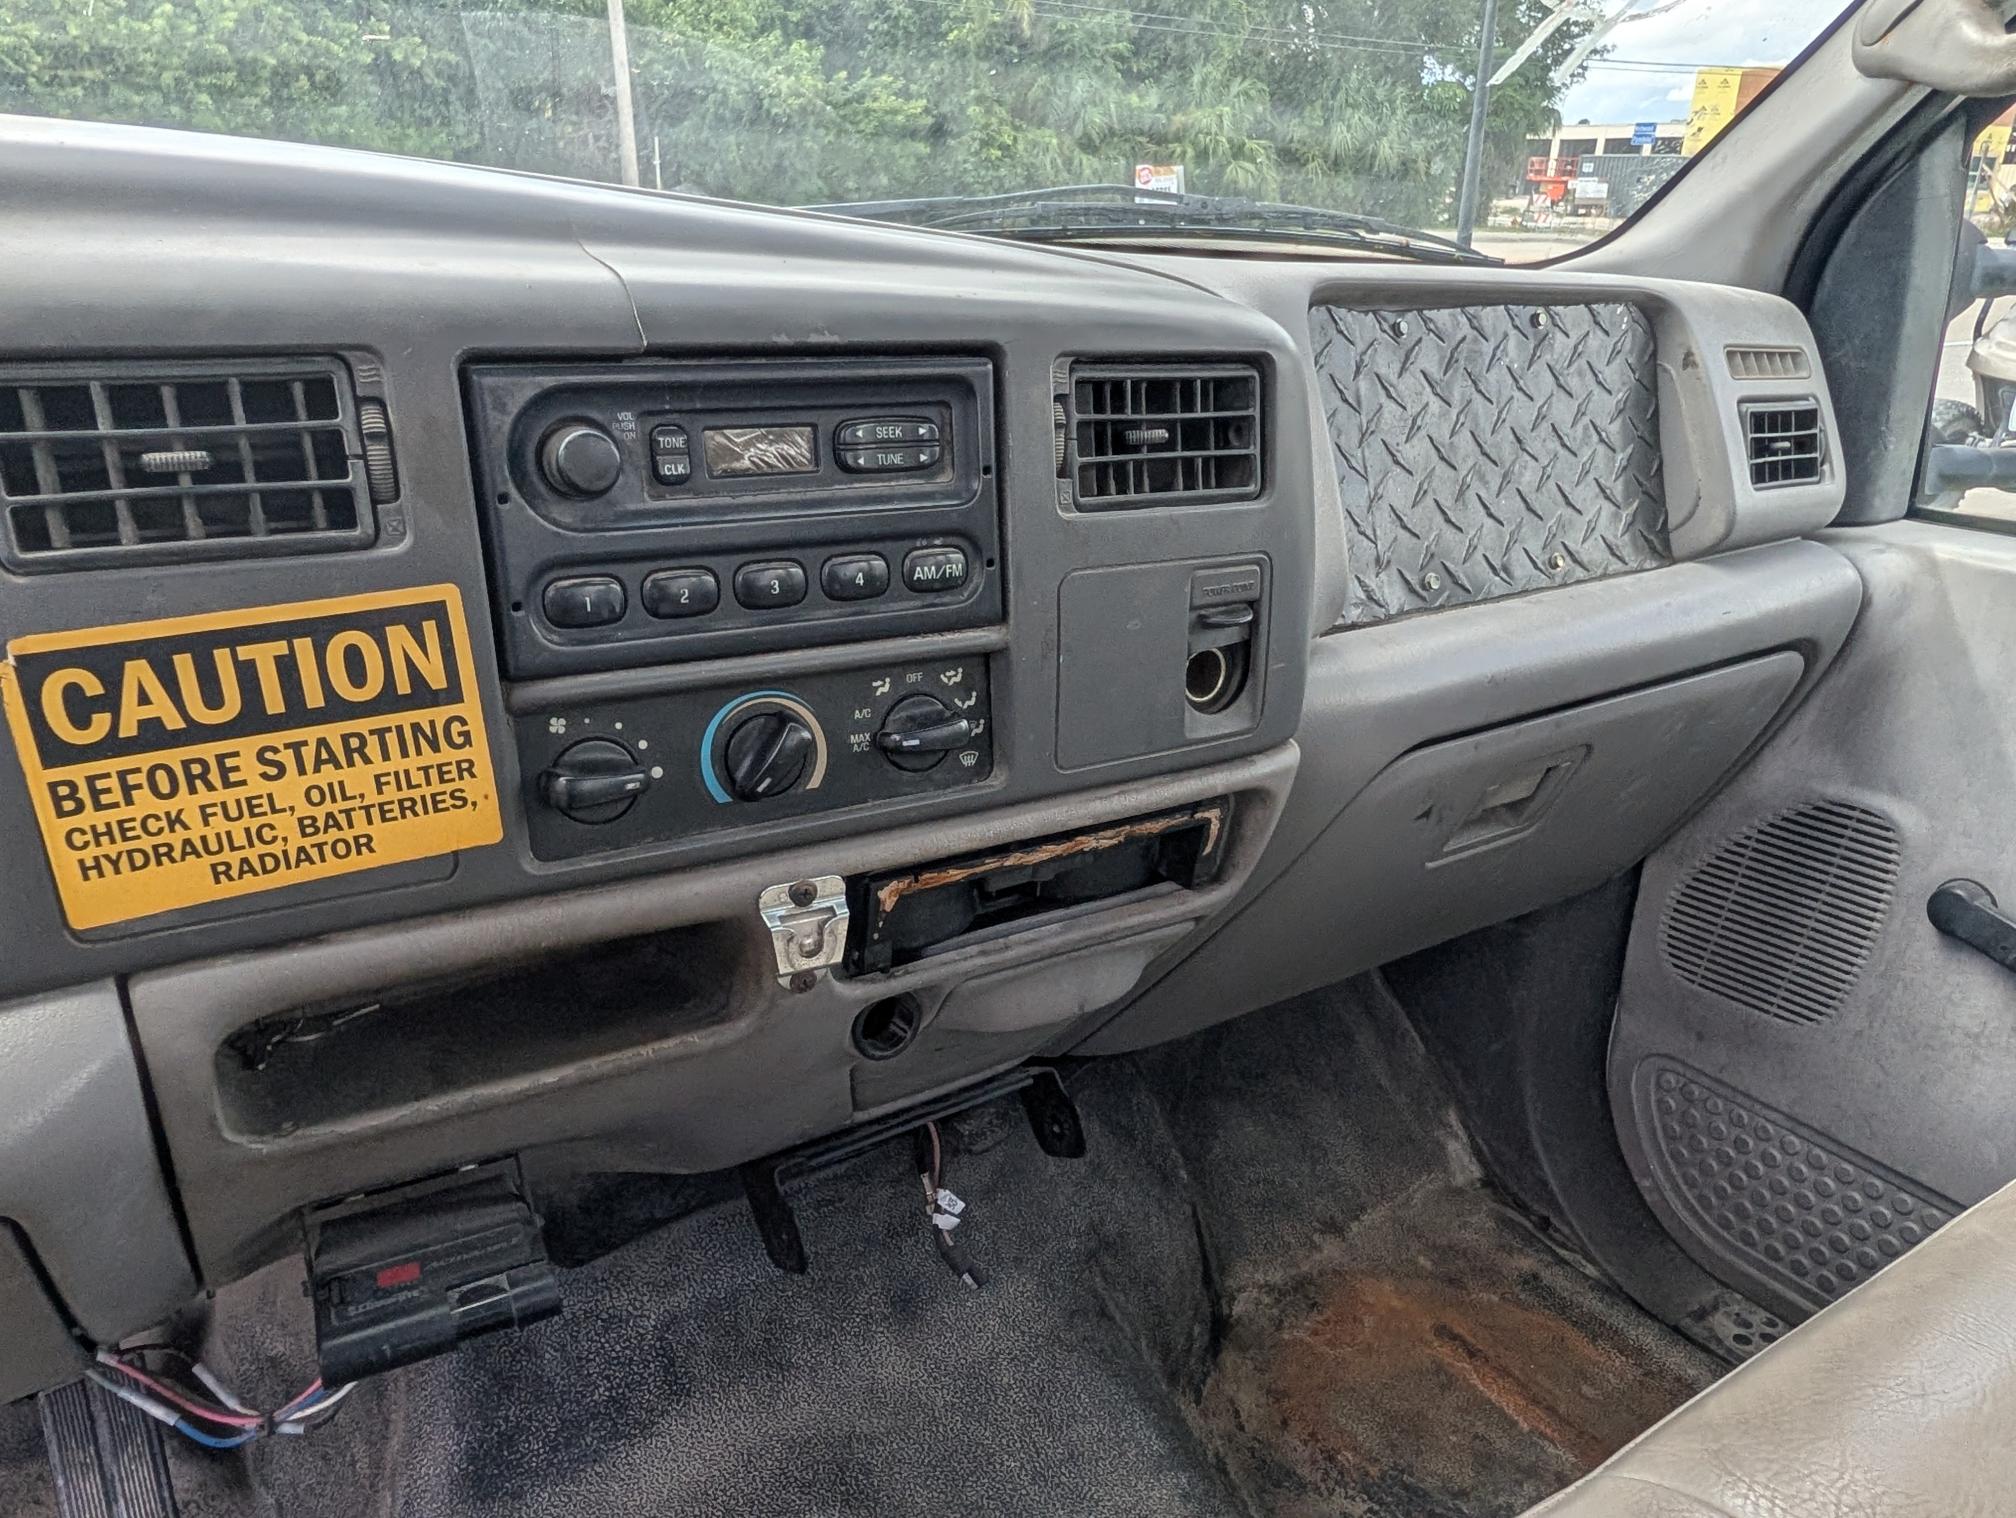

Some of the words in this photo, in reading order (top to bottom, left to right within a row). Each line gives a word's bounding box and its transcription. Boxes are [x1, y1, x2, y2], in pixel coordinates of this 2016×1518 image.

[617, 412, 634, 421] VOL
[876, 426, 902, 439] SEEK
[658, 436, 687, 449] TONE
[877, 453, 904, 465] TUNE
[664, 463, 685, 476] CLK
[855, 572, 864, 587] 4
[913, 563, 963, 581] AM/FM
[770, 579, 780, 595] 3
[680, 588, 689, 604] 2
[585, 596, 591, 612] 1
[40, 620, 448, 745] CAUTION
[906, 672, 923, 683] OFF
[854, 708, 871, 719] A/C
[850, 732, 871, 743] MAX
[853, 742, 870, 752] A/C
[47, 750, 248, 819] BEFORE
[258, 714, 475, 783] STARTING
[65, 808, 192, 852] CHECK
[200, 792, 296, 826] FUEL,
[304, 778, 365, 807] OIL,
[374, 758, 477, 796] FILTER
[77, 822, 289, 882] HYDRAULIC,
[298, 787, 479, 839] BATTERIES,
[211, 832, 376, 885] RADIATOR
